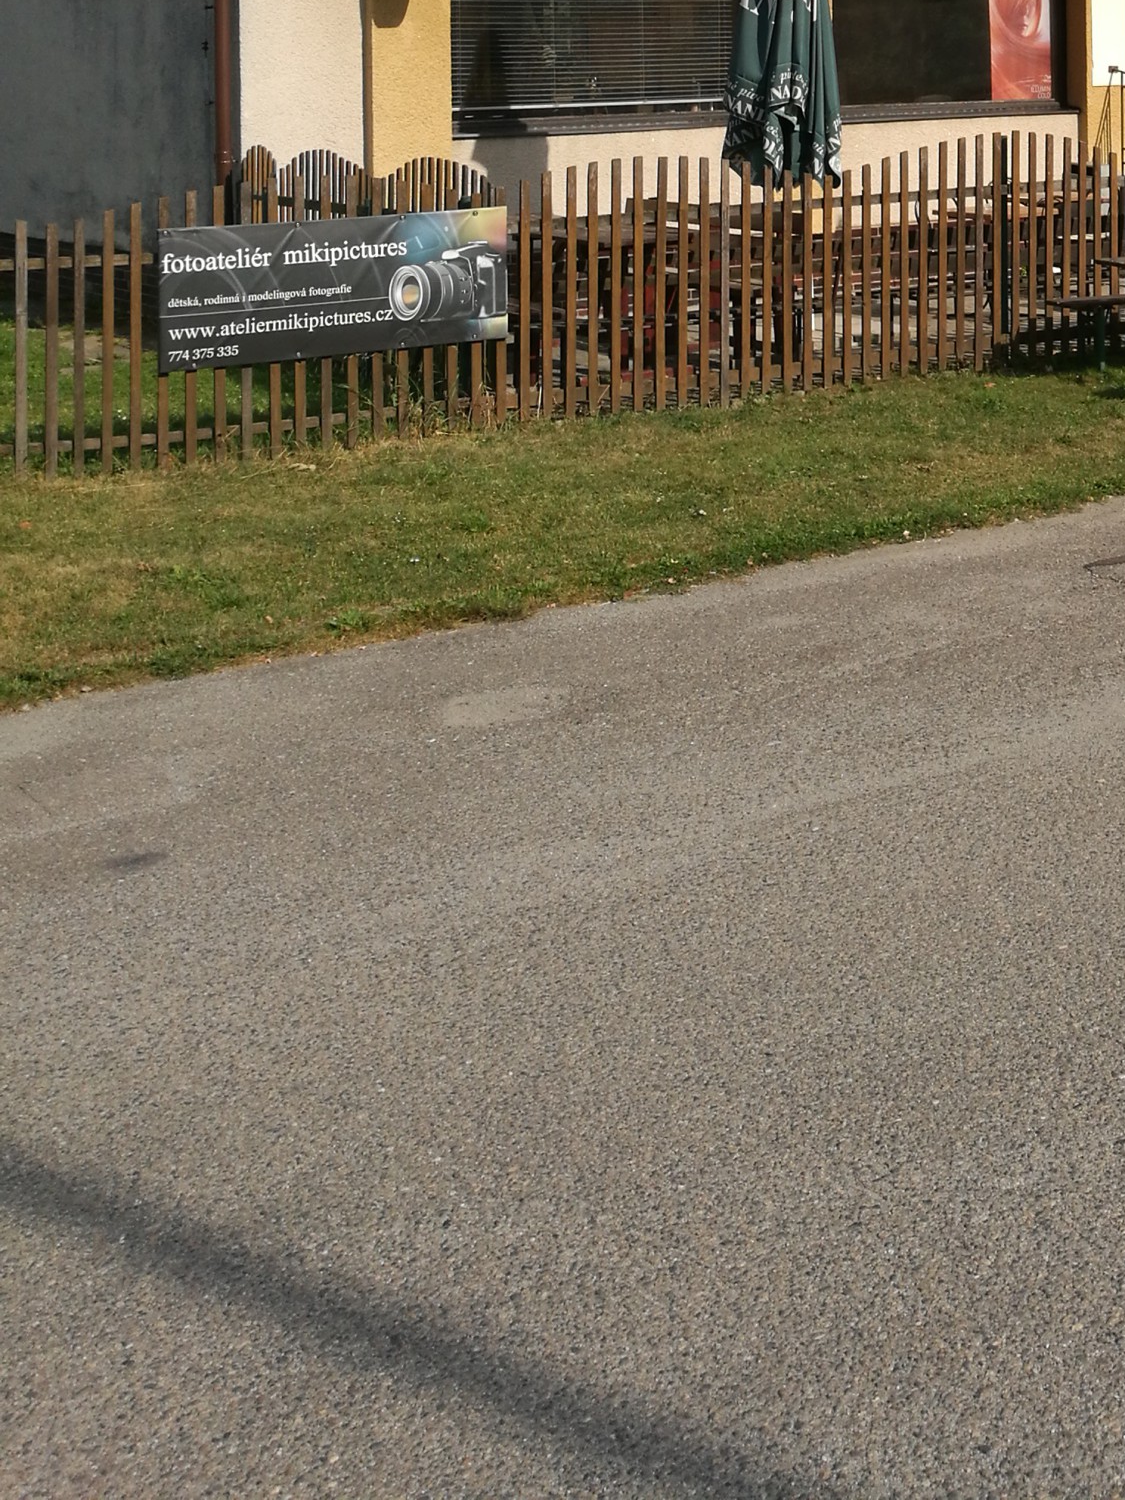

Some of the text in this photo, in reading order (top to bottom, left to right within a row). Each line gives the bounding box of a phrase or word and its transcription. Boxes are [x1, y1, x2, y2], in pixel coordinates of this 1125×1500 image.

[162, 240, 408, 275] fotoateliér mikipictures
[168, 295, 202, 308] dětská,
[204, 292, 240, 306] rodinná
[248, 287, 307, 303] modelingová
[308, 284, 353, 298] fotografie
[168, 307, 394, 341] www.ateliermikipictures.cz
[168, 345, 239, 363] 774 375 335
